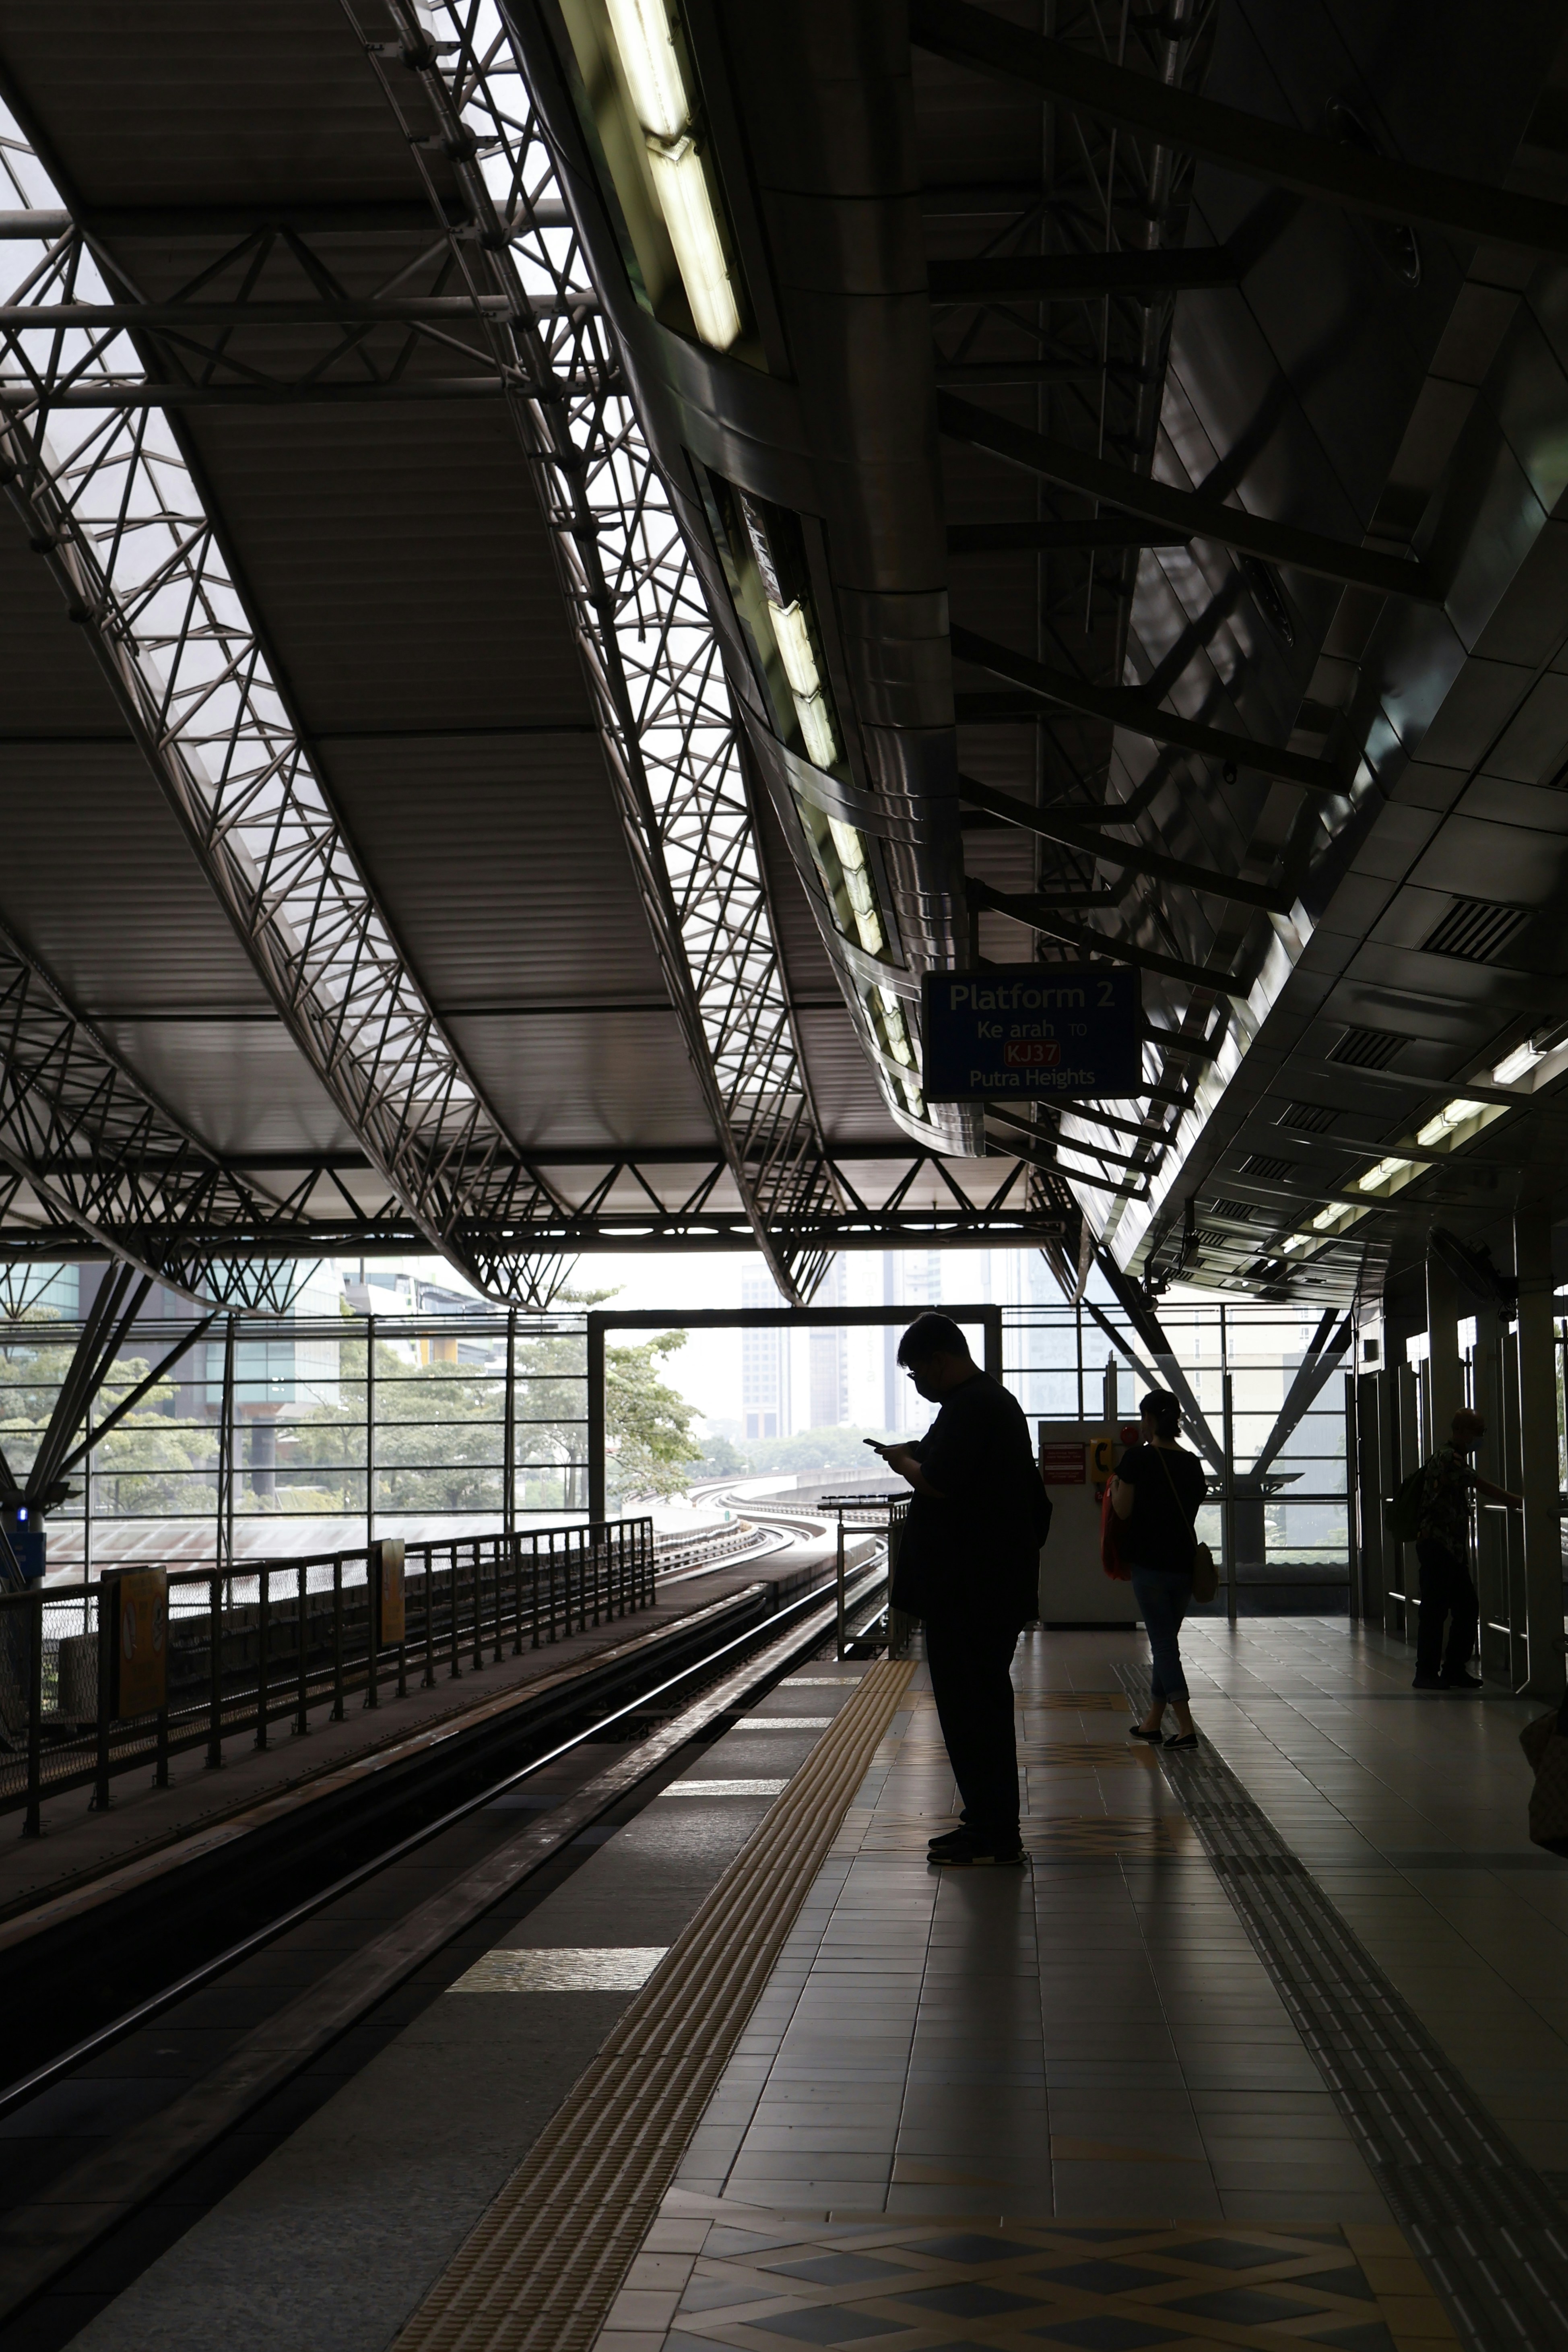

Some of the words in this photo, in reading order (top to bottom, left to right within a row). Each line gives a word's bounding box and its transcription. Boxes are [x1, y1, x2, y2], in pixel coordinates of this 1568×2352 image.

[950, 982, 1085, 1010] Platform
[1096, 981, 1115, 1007] 2
[978, 1021, 1004, 1039] Ke
[1010, 1019, 1054, 1038] arah
[1069, 1023, 1087, 1036] TO
[1007, 1044, 1058, 1063] KJ37
[970, 1070, 1020, 1087] Putra
[1026, 1068, 1096, 1089] Heights
